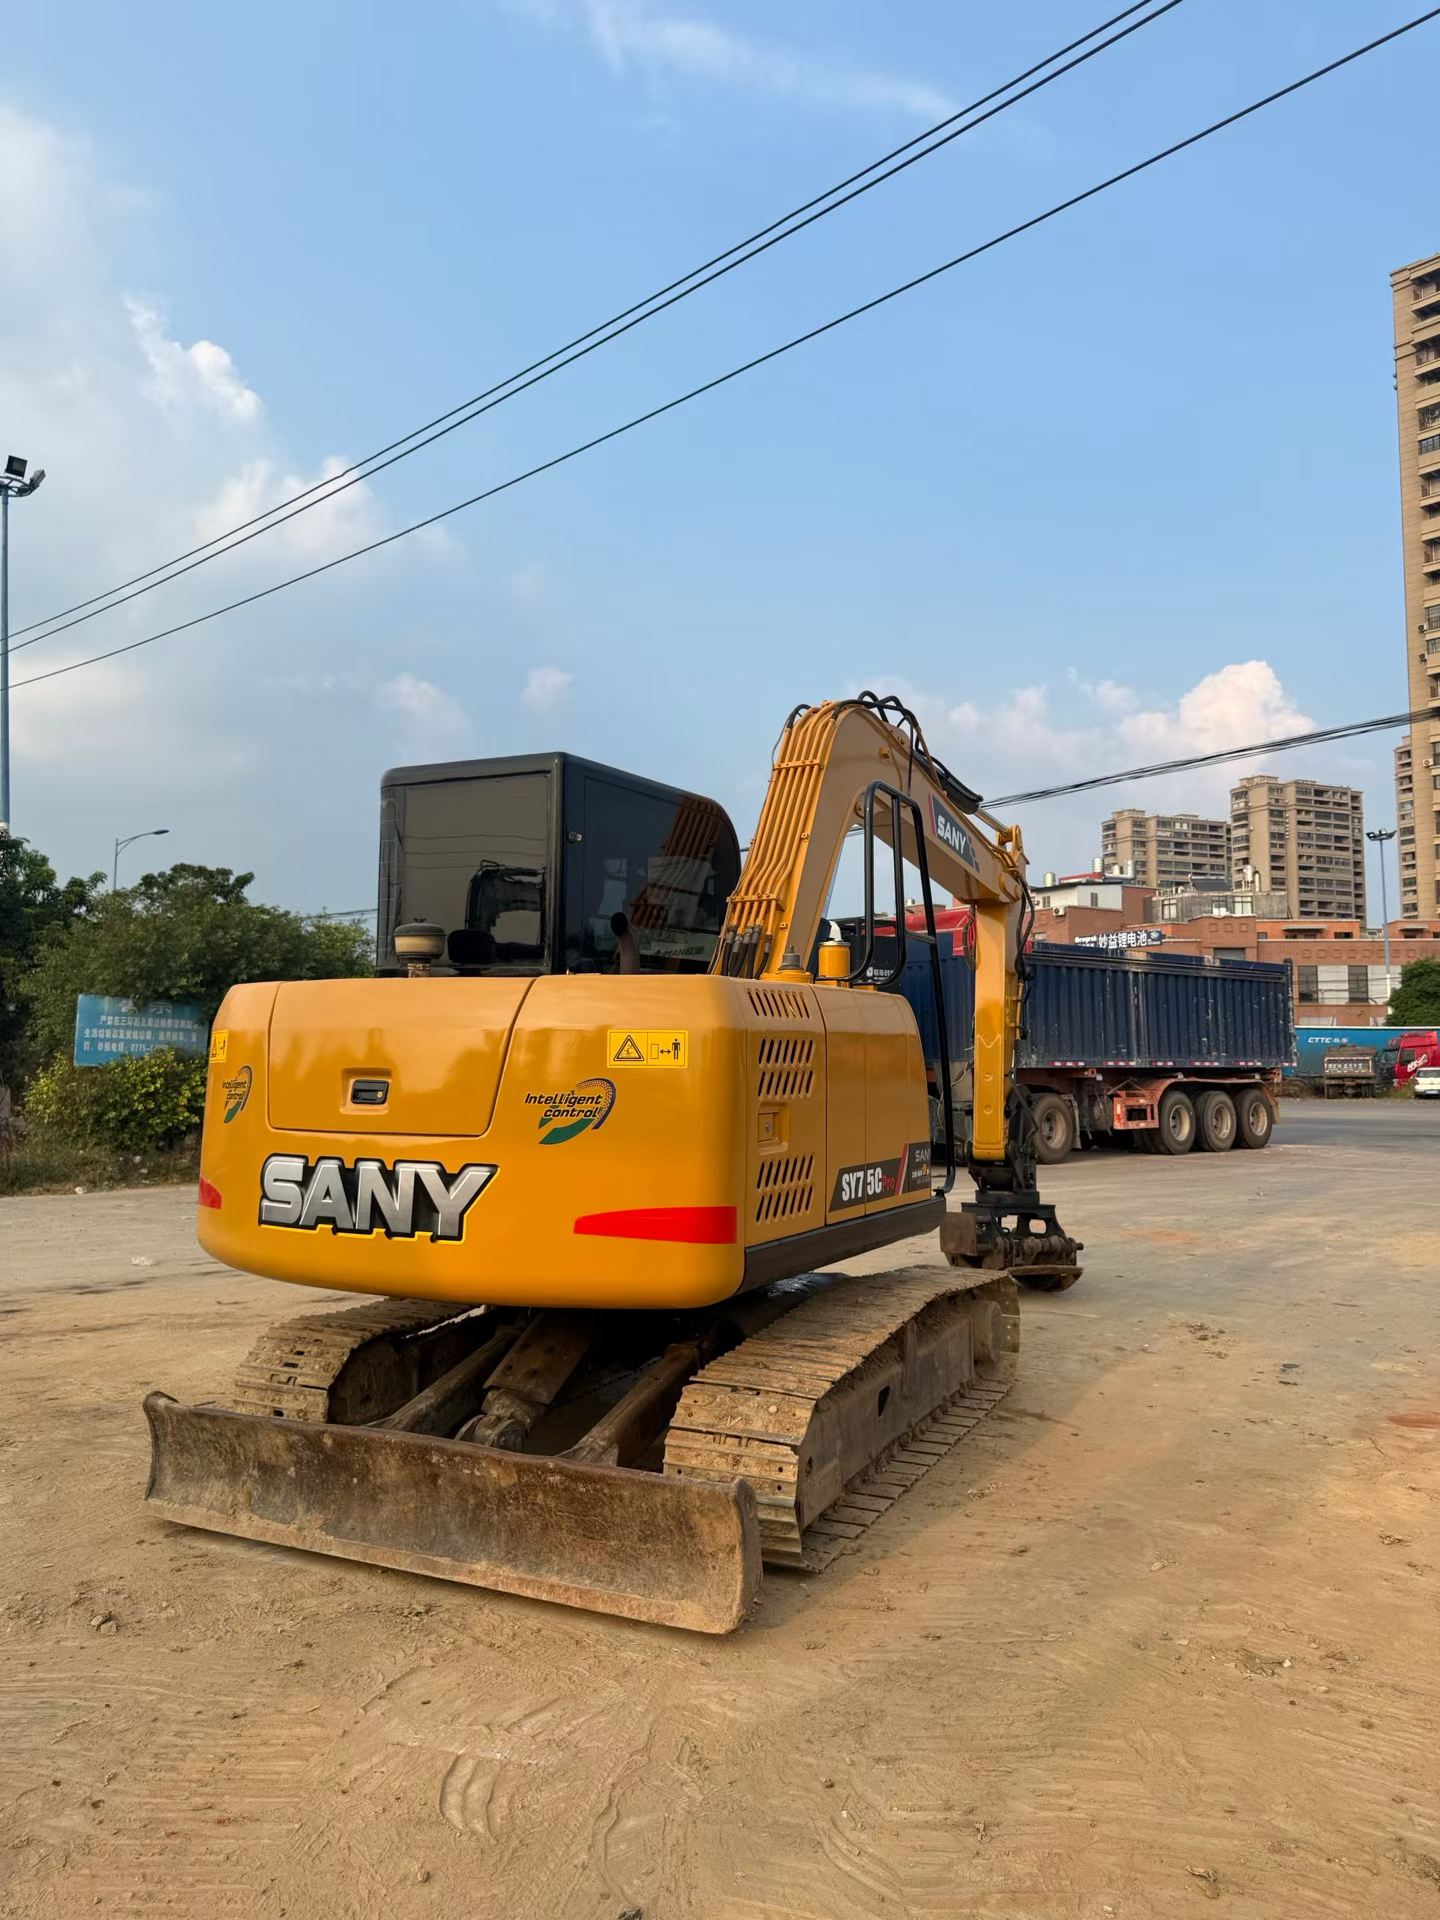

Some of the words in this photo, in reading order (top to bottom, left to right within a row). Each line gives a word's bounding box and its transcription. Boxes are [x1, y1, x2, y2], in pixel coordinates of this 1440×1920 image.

[937, 814, 967, 855] SANY
[525, 1090, 602, 1108] Intelligent
[543, 1106, 599, 1118] control
[914, 1148, 930, 1162] SAN
[258, 1153, 499, 1243] SANY
